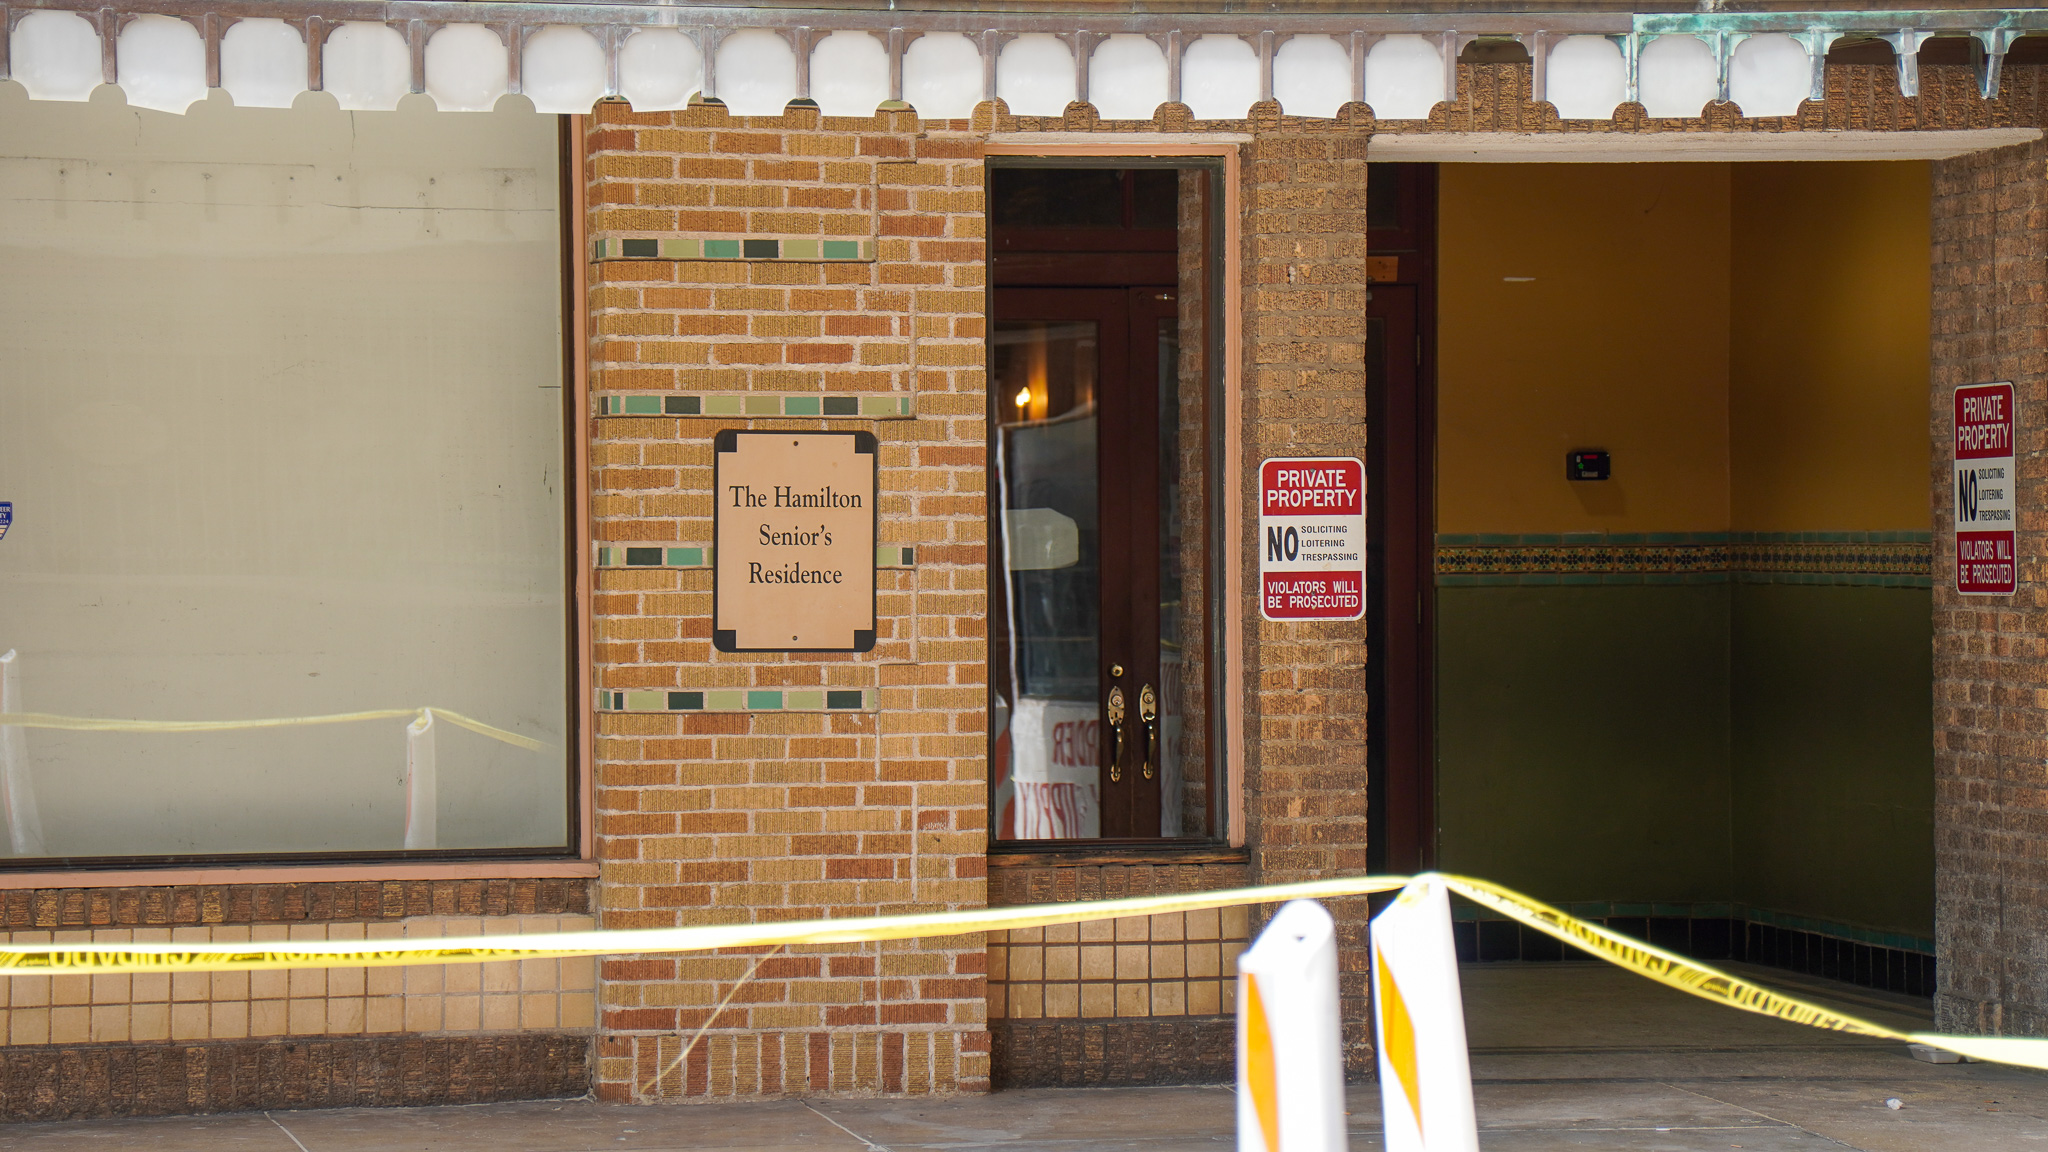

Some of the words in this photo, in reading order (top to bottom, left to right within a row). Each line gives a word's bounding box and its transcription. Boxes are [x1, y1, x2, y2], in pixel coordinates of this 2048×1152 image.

[1963, 395, 2004, 423] PRIVATE
[1958, 423, 2010, 451] PROPERTY
[1277, 469, 1346, 488] PRIVATE
[1978, 467, 2005, 480] SOLICITING
[729, 485, 767, 508] The
[773, 485, 863, 508] Hamilton
[1267, 489, 1357, 507] PROPERTY
[1959, 469, 1978, 523] NO
[1978, 488, 2004, 501] LOITERING
[1979, 509, 2011, 522] TRESPASSING
[759, 523, 833, 546] Senior's
[1301, 525, 1348, 534] SOLICITING
[1267, 526, 1299, 562] NO
[1301, 539, 1345, 548] LOITERING
[1959, 540, 1995, 560] VIOLATORS
[1996, 539, 2012, 559] WILL
[1301, 553, 1358, 562] TRESPASSING
[749, 562, 843, 584] Residence
[1960, 565, 1969, 584] BE
[1972, 564, 2012, 584] PROSECUTED
[1268, 581, 1327, 594] VIOLATORS
[1333, 581, 1358, 593] WILL
[1267, 596, 1282, 608] BE
[1289, 595, 1359, 608] PROSECUTED
